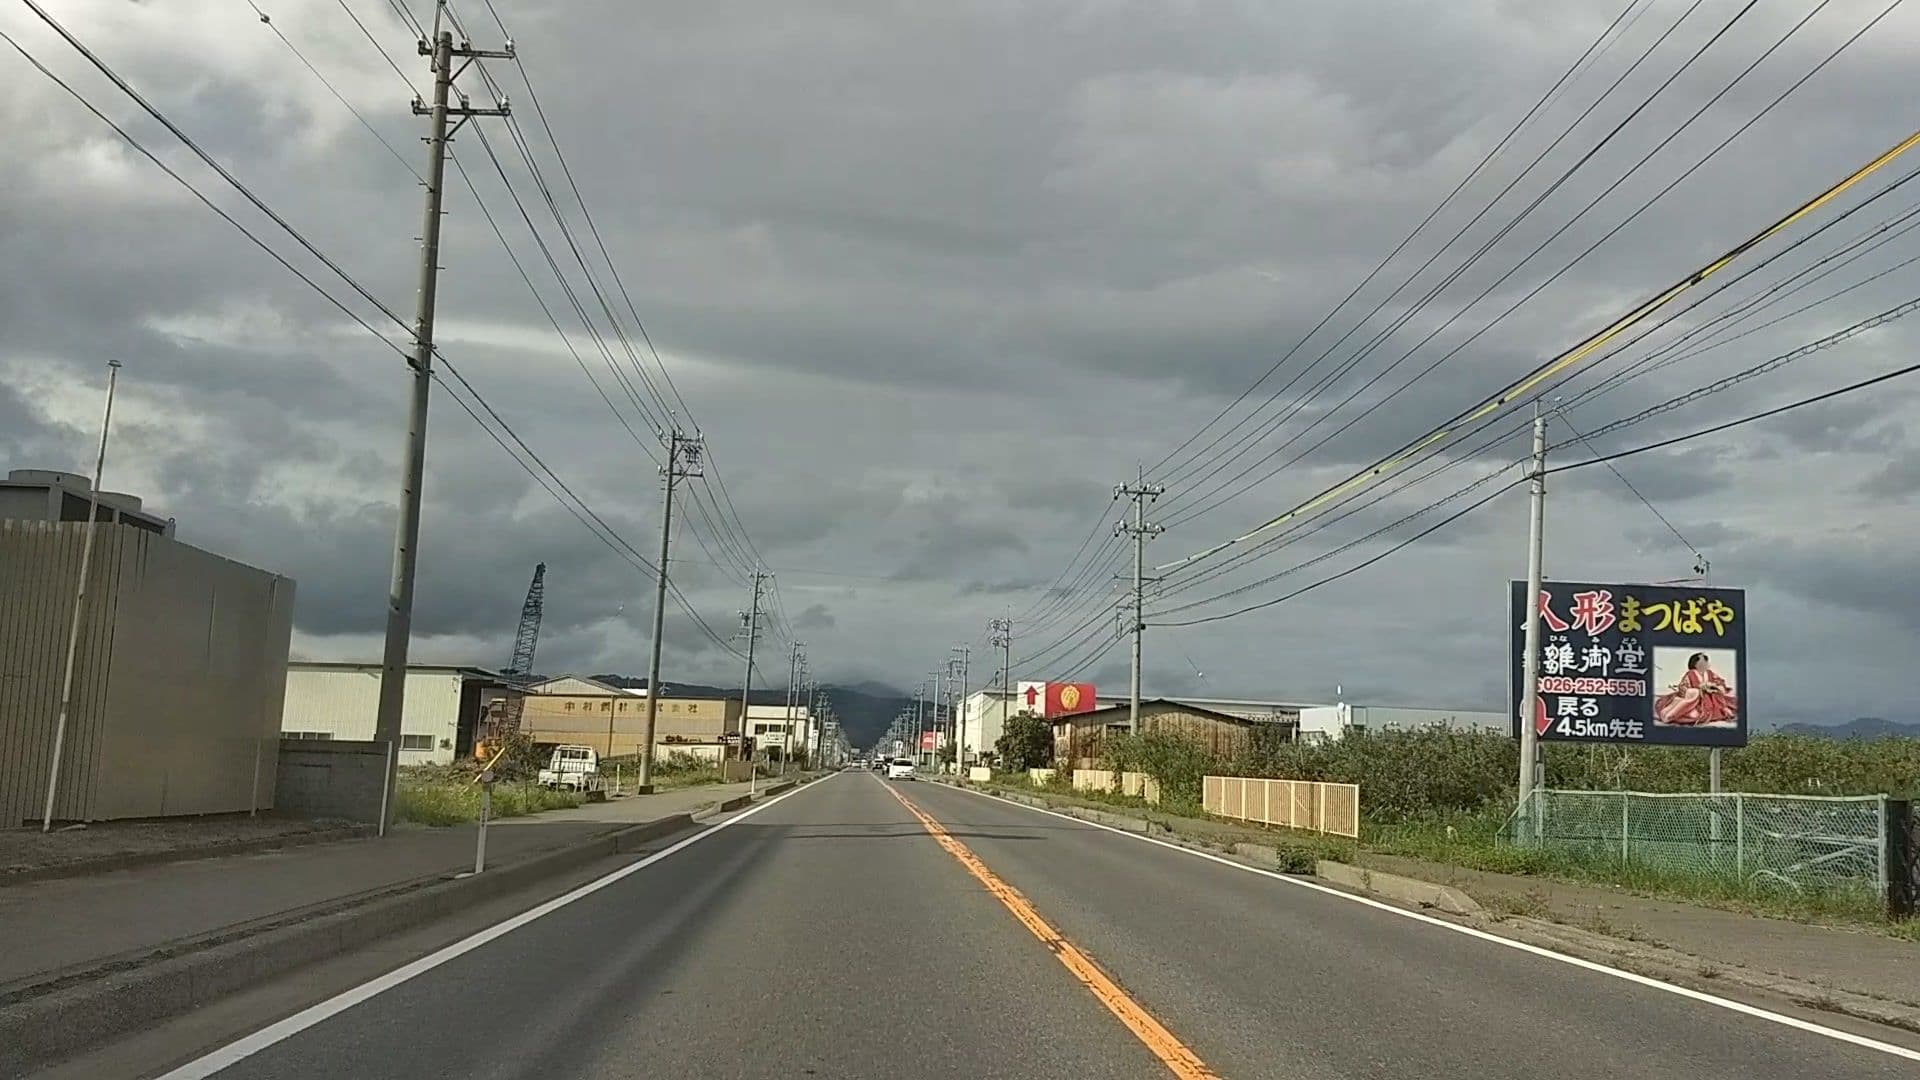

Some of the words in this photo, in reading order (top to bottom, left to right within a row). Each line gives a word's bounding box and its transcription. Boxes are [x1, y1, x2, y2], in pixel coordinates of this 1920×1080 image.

[1543, 676, 1646, 697] 026-252-5551
[1557, 696, 1599, 716] 戻る
[1556, 717, 1644, 739] 4.5km先左
